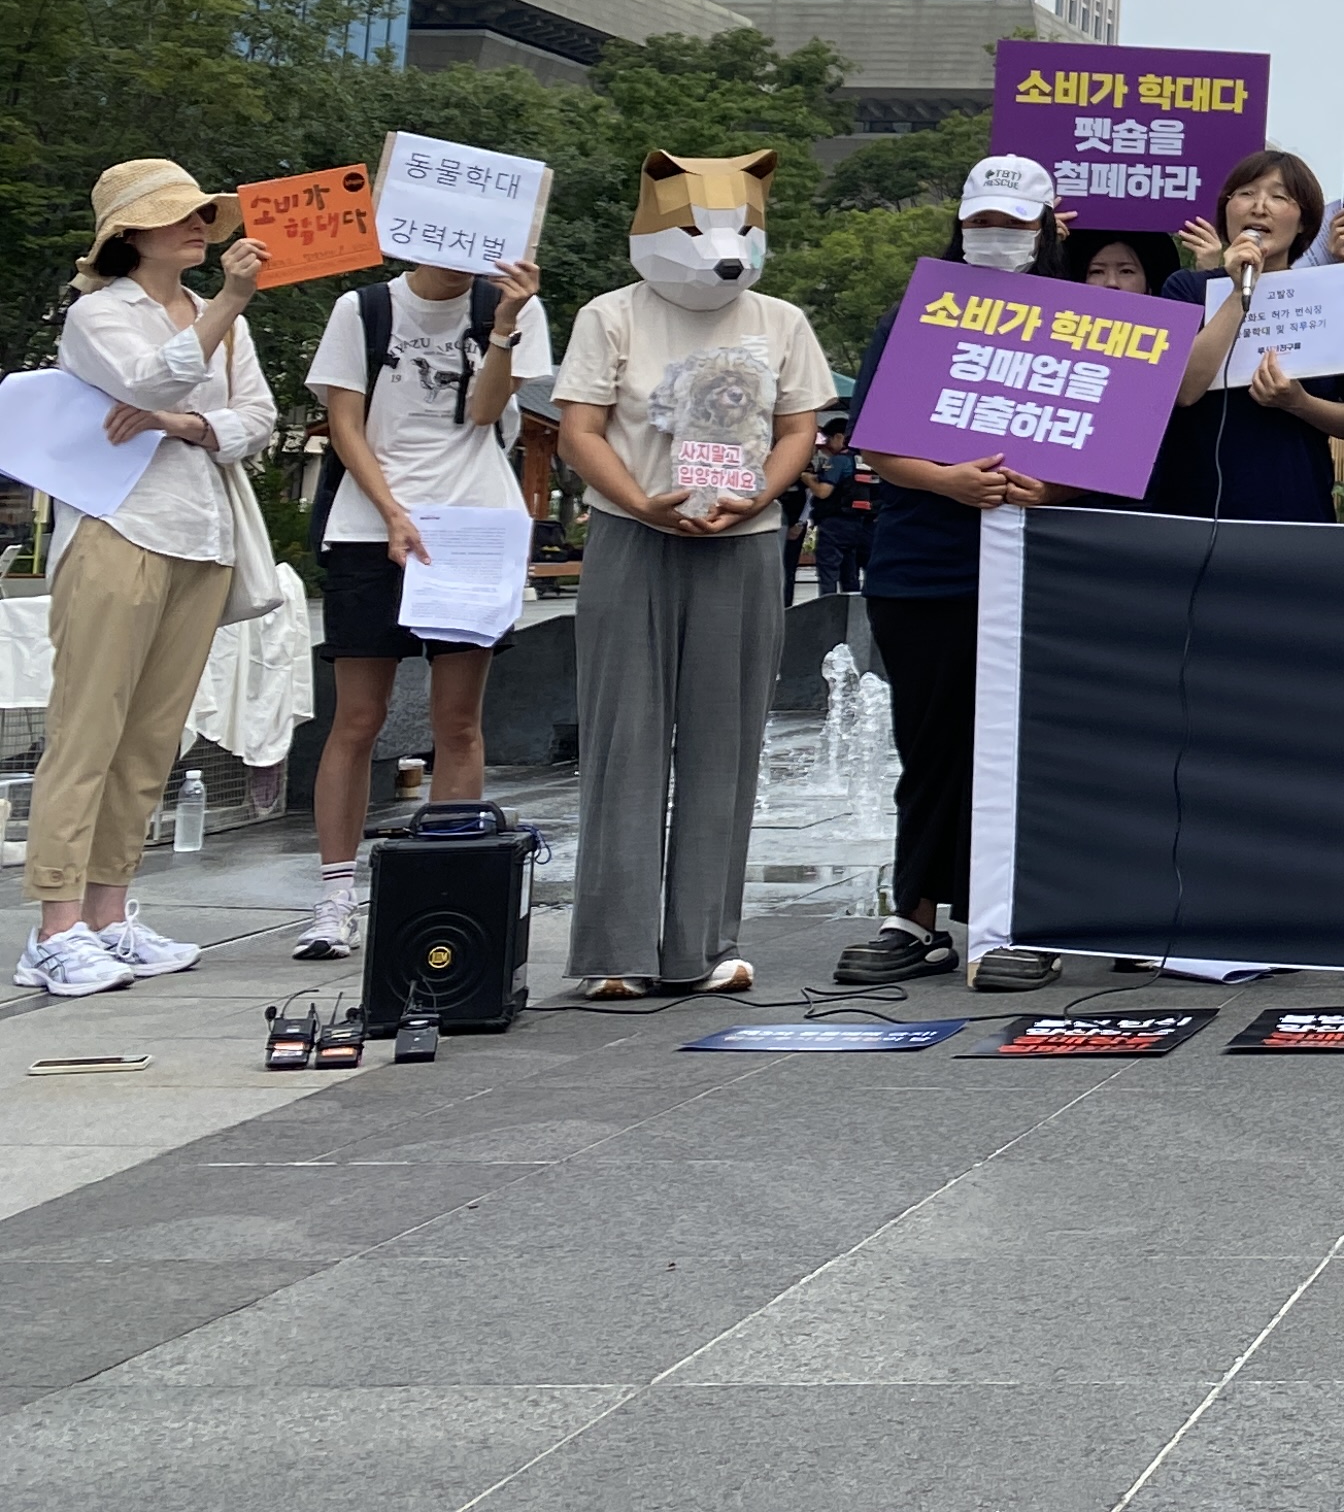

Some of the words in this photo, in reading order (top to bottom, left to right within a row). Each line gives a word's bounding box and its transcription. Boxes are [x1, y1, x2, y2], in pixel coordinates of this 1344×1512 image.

[1016, 70, 1128, 107] 소비가
[1138, 74, 1248, 113] 학대다
[1074, 117, 1185, 155] 펫숍을
[404, 152, 521, 199] 동물학대
[1054, 161, 1202, 201] 철폐하라
[250, 184, 330, 225] 소비가
[390, 217, 506, 262] 강력처벌
[1244, 312, 1266, 323] 화도
[1271, 308, 1290, 320] 허가
[1294, 304, 1322, 317] 번식장
[1266, 288, 1296, 300] 고발장
[919, 291, 1042, 341] 소비가
[1050, 310, 1170, 365] 학대다
[1239, 326, 1271, 339] 물학대
[950, 341, 1111, 403] 경매업을
[929, 388, 1094, 450] 퇴출하라
[680, 442, 741, 464] 사지말고
[679, 467, 755, 490] 입양하세요
